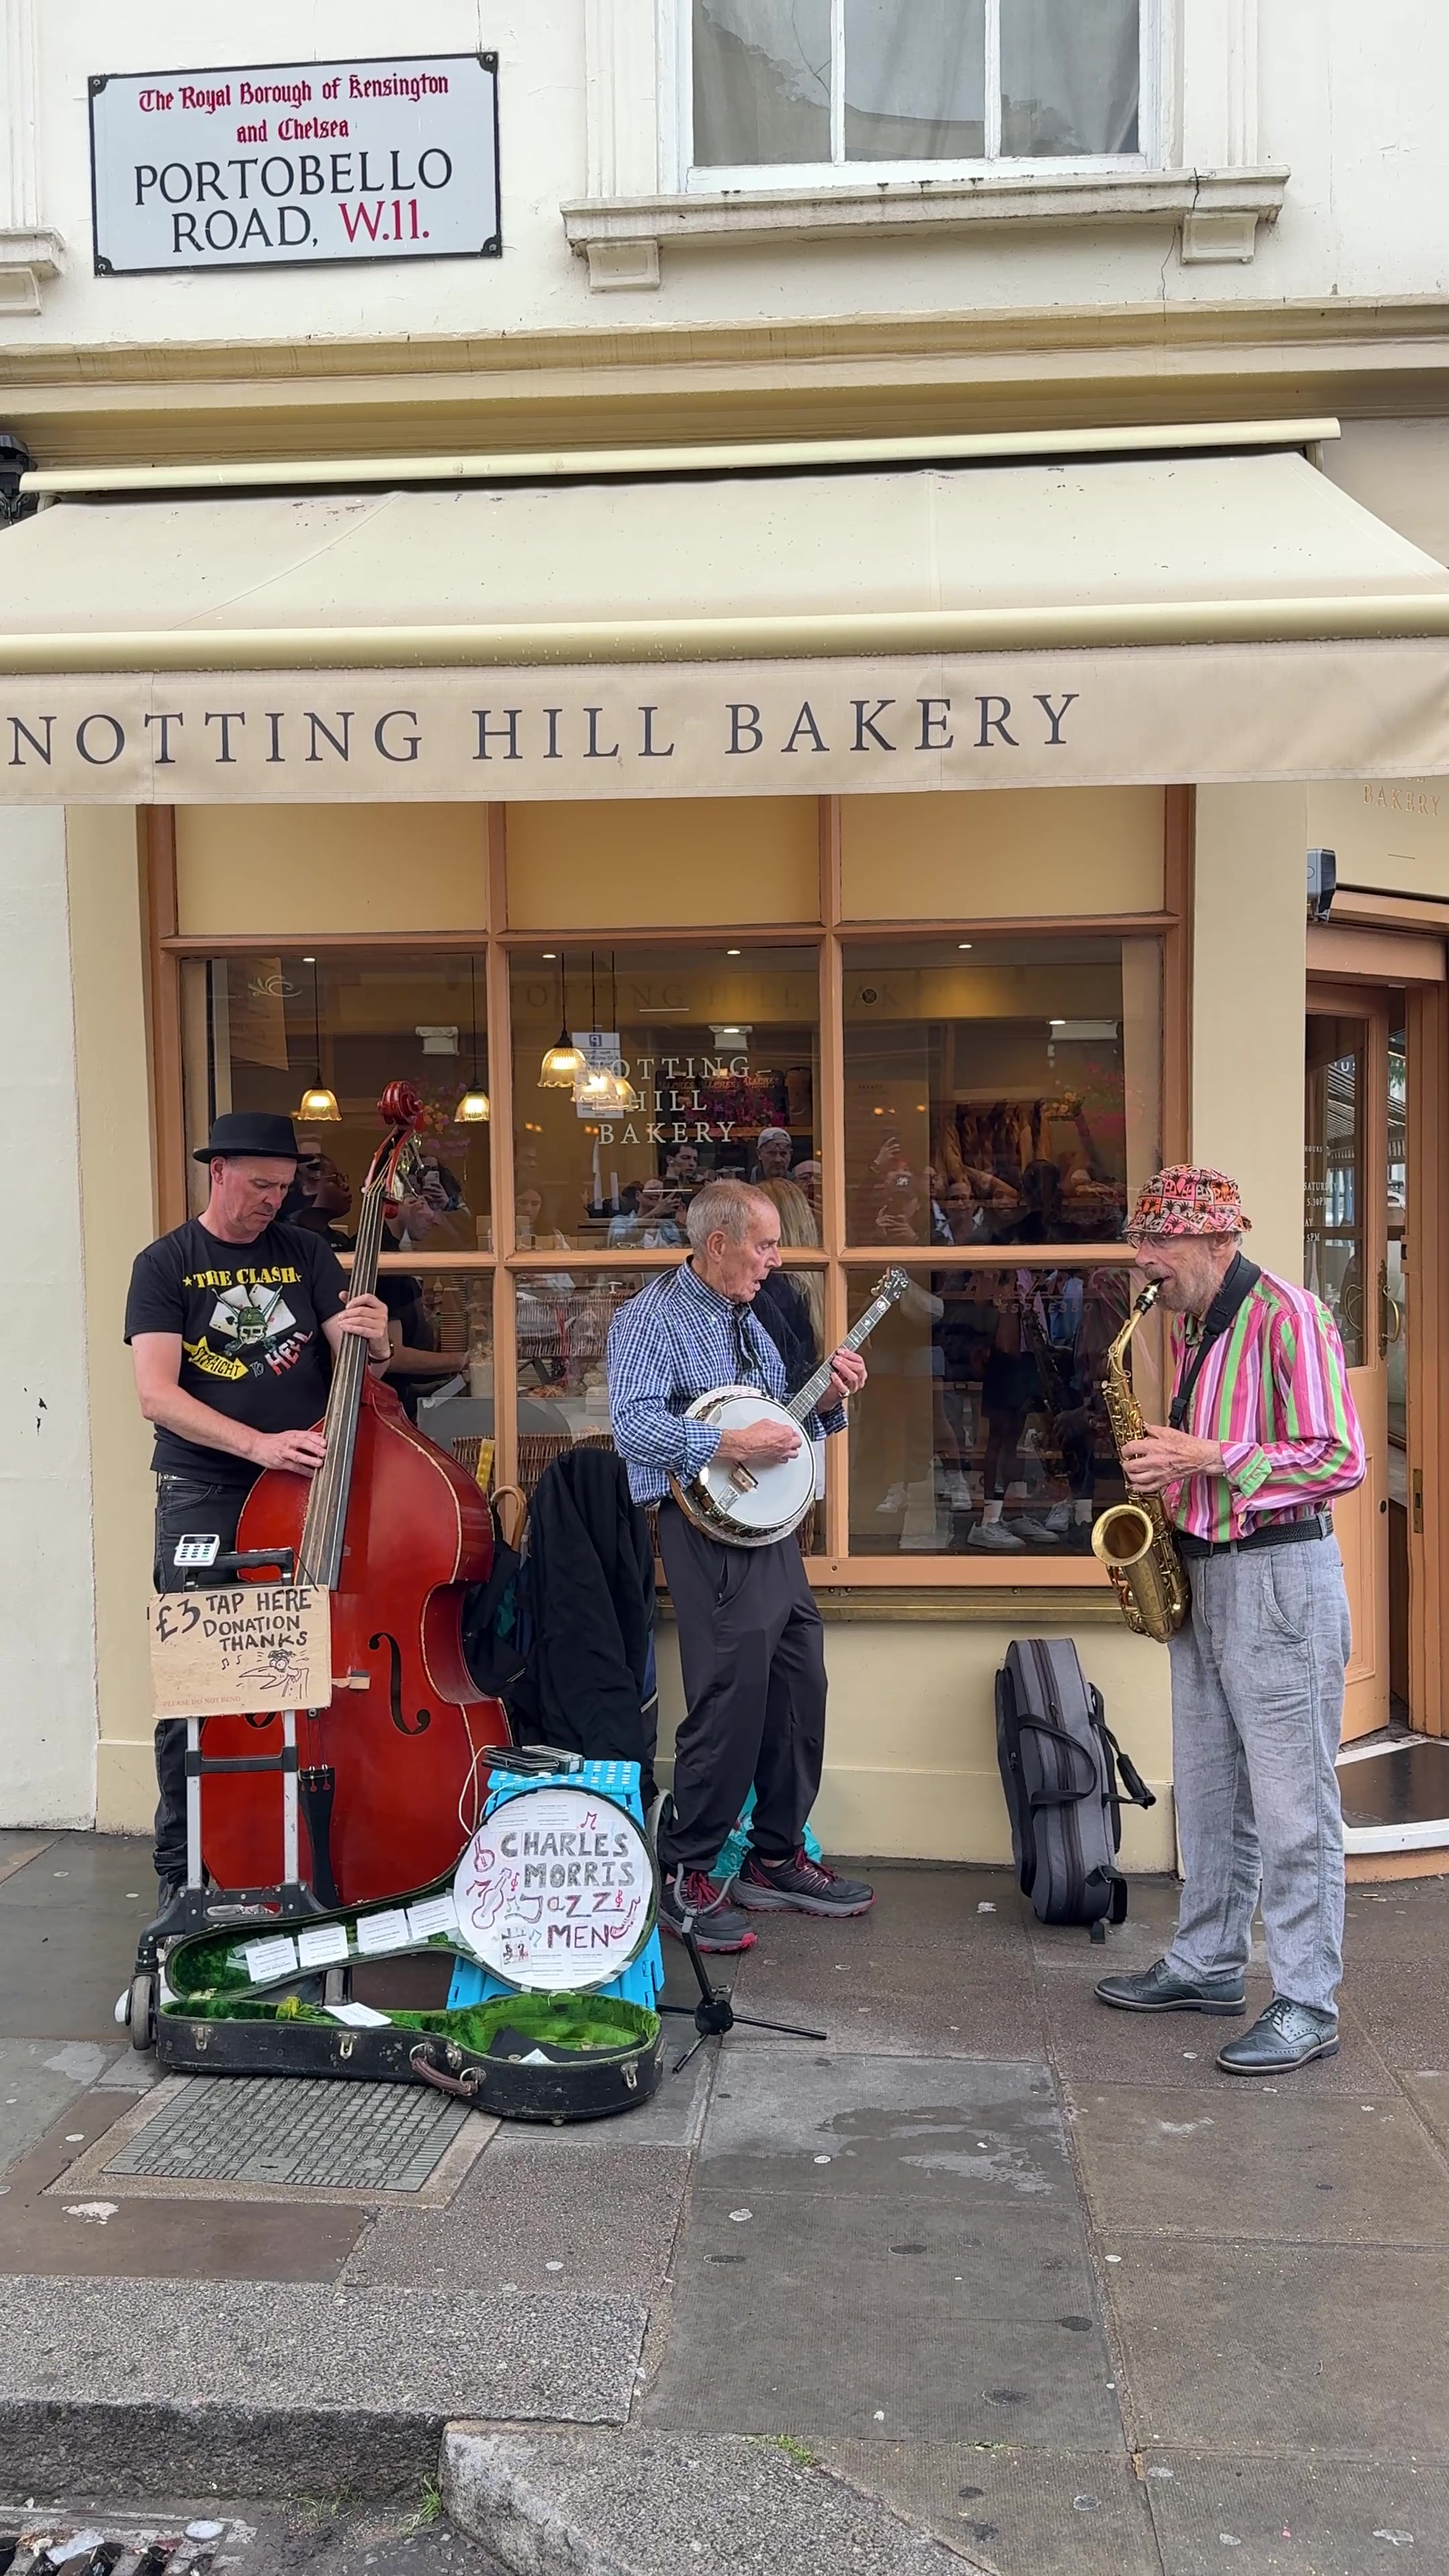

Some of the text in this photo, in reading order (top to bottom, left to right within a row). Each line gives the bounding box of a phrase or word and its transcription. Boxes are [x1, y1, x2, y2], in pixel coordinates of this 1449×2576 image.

[138, 73, 449, 114] The Royal Borough of Kensington
[236, 117, 349, 143] and Chelsea
[134, 148, 452, 205] PORTOBELLO
[172, 199, 430, 253] ROAD, W.11.
[7, 694, 1079, 765] NOTTING HILL BAKERY
[1363, 784, 1440, 816] BAKERY
[627, 1090, 707, 1112] HILL
[598, 1122, 735, 1144] BAKERY
[193, 1267, 297, 1288] THE CLASH
[192, 1330, 313, 1378] STRAIGHT TO HELL
[206, 1588, 312, 1615] TAP HERE
[156, 1599, 201, 1642] £3
[203, 1615, 300, 1638] DONATION
[219, 1631, 307, 1652] THANKS
[500, 1832, 629, 1858] CHARLES
[524, 1862, 635, 1888] MORRIS
[547, 1923, 611, 1949] MEN
